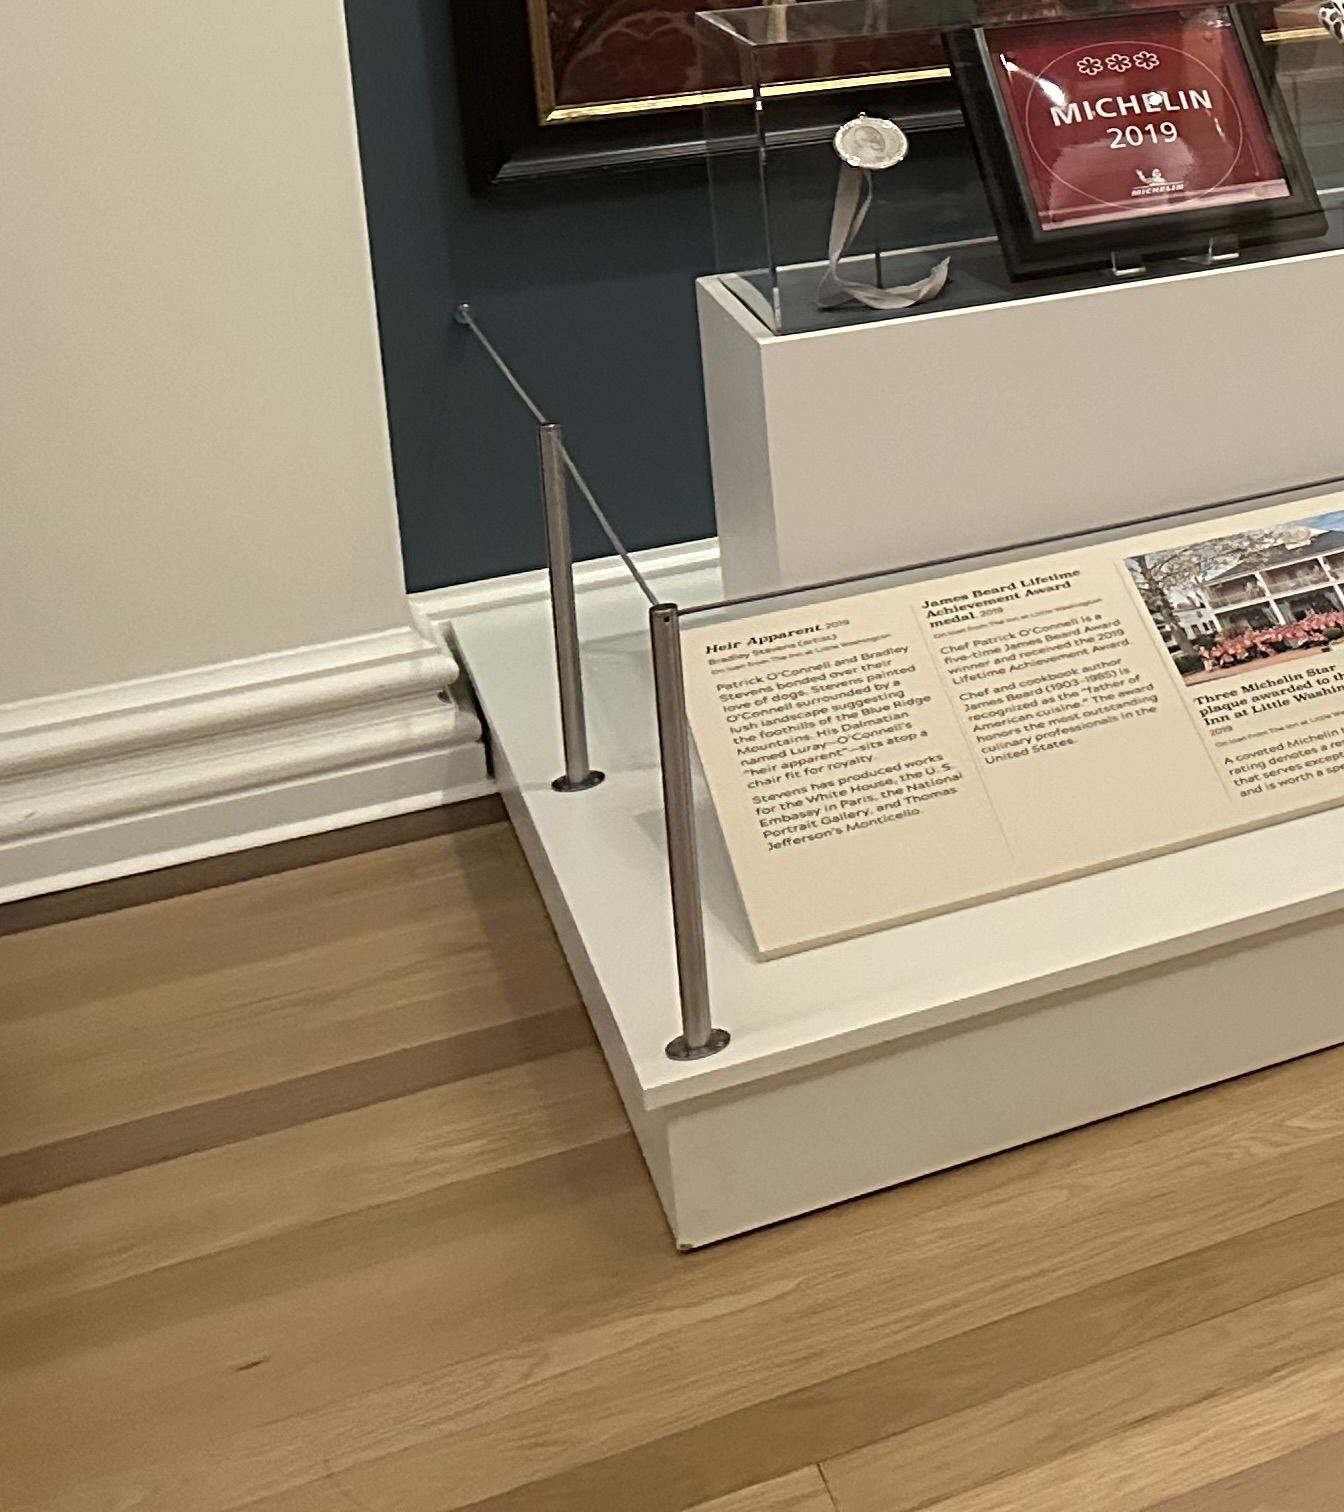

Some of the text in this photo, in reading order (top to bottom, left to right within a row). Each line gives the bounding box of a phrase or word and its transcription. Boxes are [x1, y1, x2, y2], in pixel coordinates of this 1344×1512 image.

[1049, 88, 1213, 126] MICHELIN
[1106, 120, 1179, 150] 2019
[922, 570, 1080, 609] James Beard Lifetime
[926, 592, 1021, 619] Achievement
[1025, 580, 1071, 597] Award
[706, 642, 742, 654] Heir
[1193, 665, 1336, 705] Three Michelin Star
[1199, 699, 1248, 717] plaque
[1251, 680, 1313, 703] awarded
[1316, 678, 1330, 686] to
[1203, 715, 1230, 726] Inn
[1234, 709, 1249, 718] at
[1251, 699, 1290, 714] Little
[1224, 757, 1234, 765] A
[1235, 742, 1285, 762] coveted
[1286, 729, 1339, 748] Michelin
[1228, 761, 1267, 776] rating
[1268, 747, 1318, 765] denotes
[1320, 744, 1328, 752] a
[1233, 774, 1261, 787] that
[1262, 763, 1304, 779] serves
